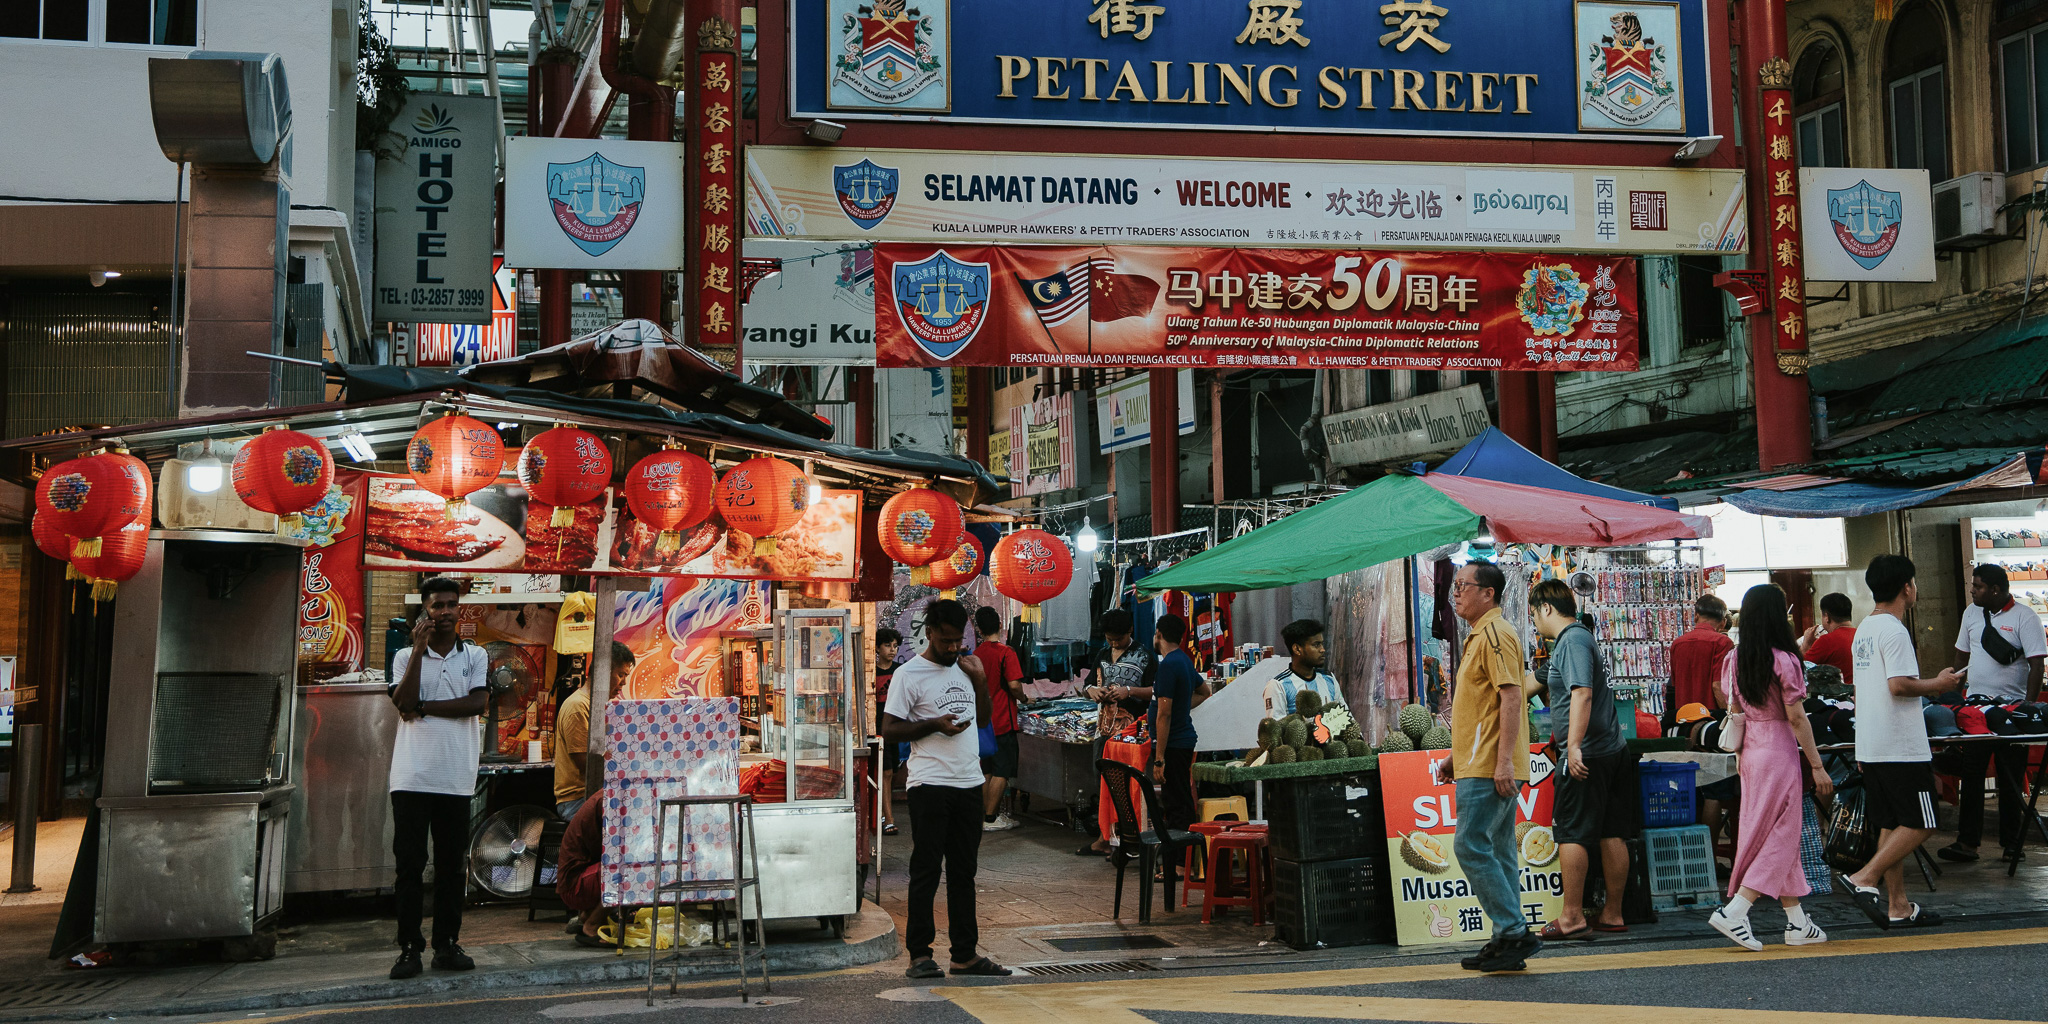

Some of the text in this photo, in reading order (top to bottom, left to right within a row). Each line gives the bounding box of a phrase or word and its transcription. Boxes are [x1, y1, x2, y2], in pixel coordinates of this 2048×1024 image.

[841, 71, 938, 100] Dewan Bandaraya Kuala Lumpur
[996, 55, 1538, 115] PETALING STREET
[410, 137, 461, 149] AMIGO
[923, 173, 1138, 205] SELAMAT DATANG
[1176, 179, 1291, 208] WELCOME
[1325, 187, 1443, 219] 欢迎光临
[1473, 188, 1568, 215] நல்வரவு
[1595, 178, 1616, 240] 丙申年
[415, 153, 454, 284] HOTEL
[573, 219, 621, 234] KUALA LUMPUR
[587, 217, 607, 225] 1953
[932, 223, 970, 233] KUALA
[972, 224, 1018, 234] LUMPUR
[1080, 226, 1087, 235] &
[1090, 226, 1123, 236] PETTY
[1180, 228, 1250, 238] ASSOCIATION
[1381, 231, 1561, 244] PERSATUAN PENJAJA DAN PENIAGA KECIL KUALA LUMPUR
[380, 288, 400, 304] TEL
[411, 288, 455, 306] 03-2857
[458, 289, 484, 306] 3999
[935, 318, 952, 326] 1953
[1588, 309, 1622, 321] LOONG
[920, 320, 968, 335] KUALA LUMPUR
[931, 334, 951, 342] PETTY
[970, 308, 981, 325] ASSN.
[1167, 316, 1480, 333] Ulang Tahun Ke-50 Hubungan Diplomatik Malaysia-China
[1592, 321, 1617, 333] KEE
[421, 323, 450, 361] BUKA
[453, 324, 480, 365] 24
[483, 317, 513, 361] JAM
[1167, 334, 1480, 350] 50th Anniversary of Malaysia-China Diplomatic Relations
[1010, 353, 1207, 365] PERSATUAN PENJAJA DAN PENIAGA KECIL K.L.
[1309, 356, 1324, 365] K.L.
[1371, 357, 1377, 366] &
[1379, 357, 1403, 366] PETTY
[1446, 357, 1502, 367] ASSOCIATION
[1526, 350, 1541, 363] Try
[1581, 351, 1600, 362] Love
[1125, 393, 1149, 428] FAMILY
[1420, 404, 1459, 444] HOONG
[1456, 397, 1488, 437] HING
[460, 429, 496, 444] LOONG
[469, 444, 496, 459] KEE
[642, 461, 683, 478] LOONG
[647, 476, 678, 491] KEE
